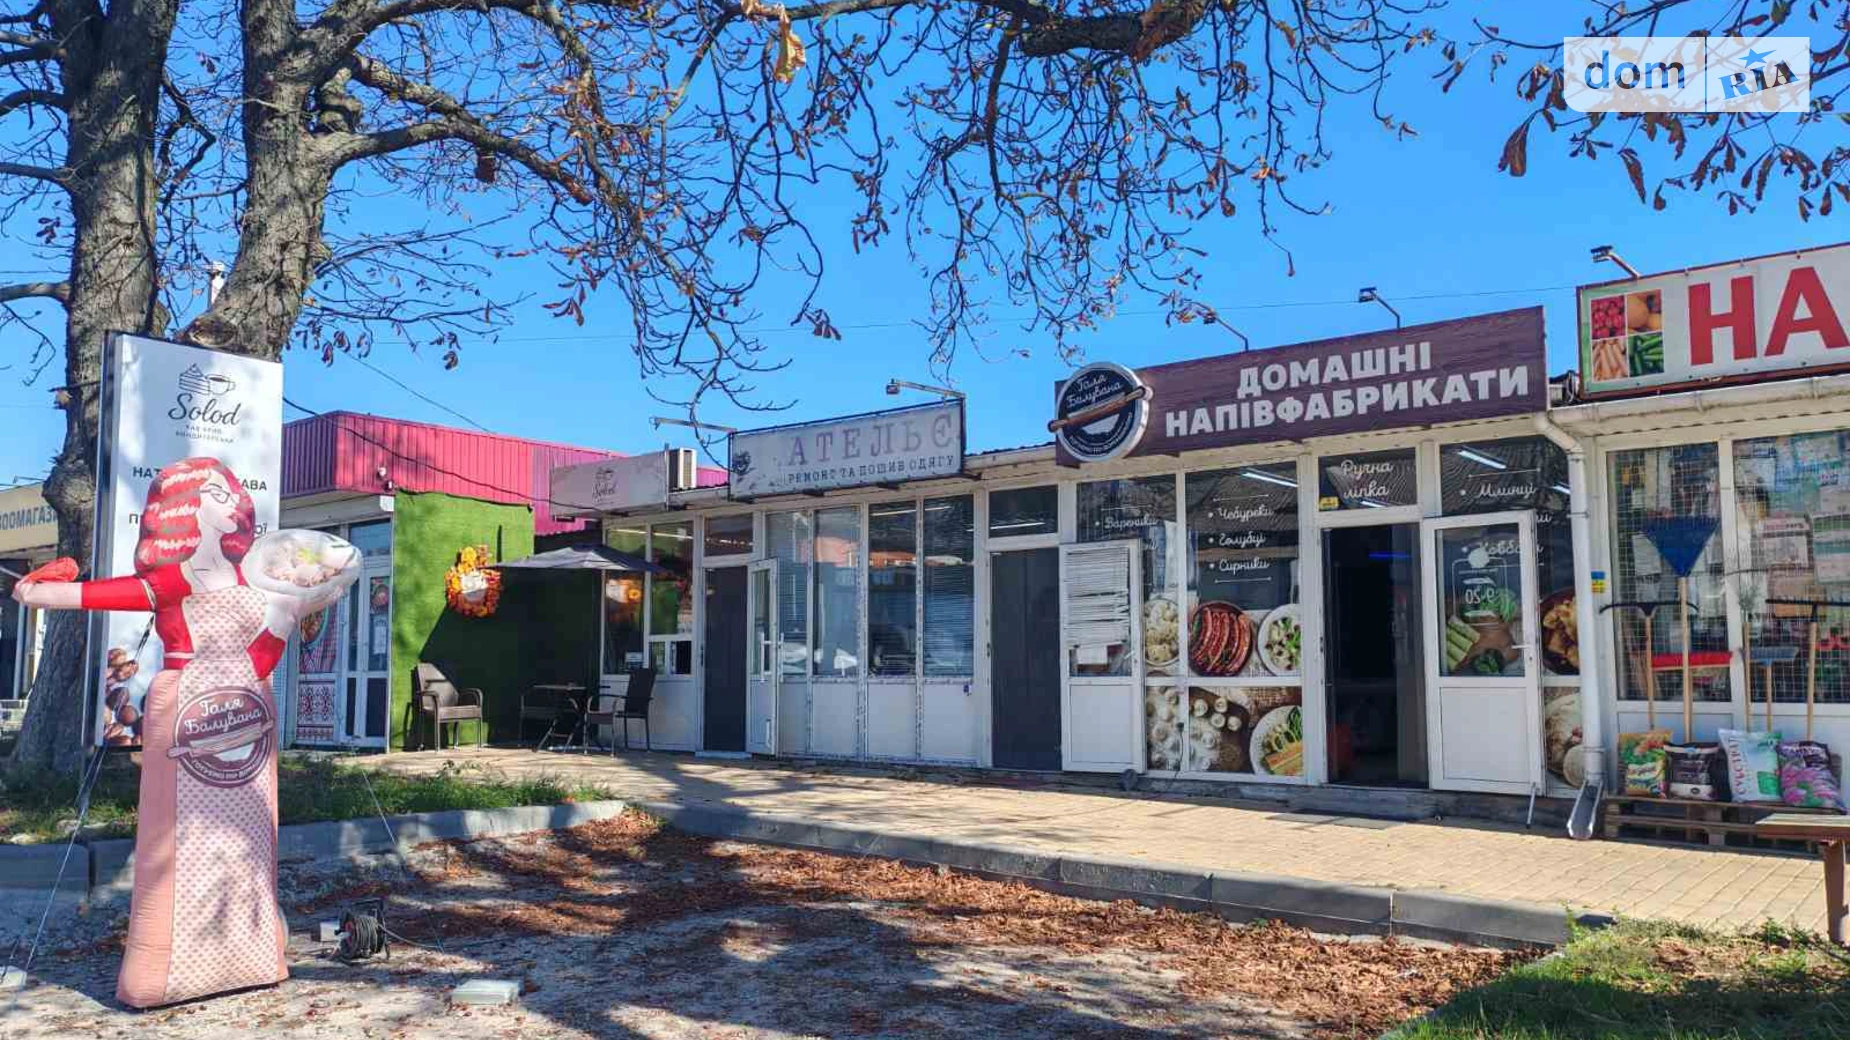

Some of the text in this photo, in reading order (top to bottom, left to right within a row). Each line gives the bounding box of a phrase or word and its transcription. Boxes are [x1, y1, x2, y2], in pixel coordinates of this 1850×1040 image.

[1687, 266, 1850, 366] НА
[1237, 341, 1431, 398] ДОМАШНІ
[1077, 375, 1107, 391] Галя
[1066, 382, 1121, 407] Балувана
[1165, 365, 1529, 437] НАПІВФАБРИКАТИ
[168, 393, 241, 425] Solod
[788, 413, 953, 466] АТЕЛЬЄ
[788, 455, 954, 484] РЕМОНТ ТА ПОШИВ ОДЯГУ
[1340, 459, 1394, 480] Ручна
[238, 478, 267, 491] АВА
[1343, 479, 1391, 499] ліпка
[1476, 483, 1537, 500] Млинці
[1105, 513, 1157, 530] Вареники
[1217, 506, 1273, 523] Чебуреки
[1219, 532, 1267, 551] Голубці
[1219, 555, 1271, 574] Сирники
[199, 698, 245, 717] Галя
[184, 708, 262, 735] Балувана
